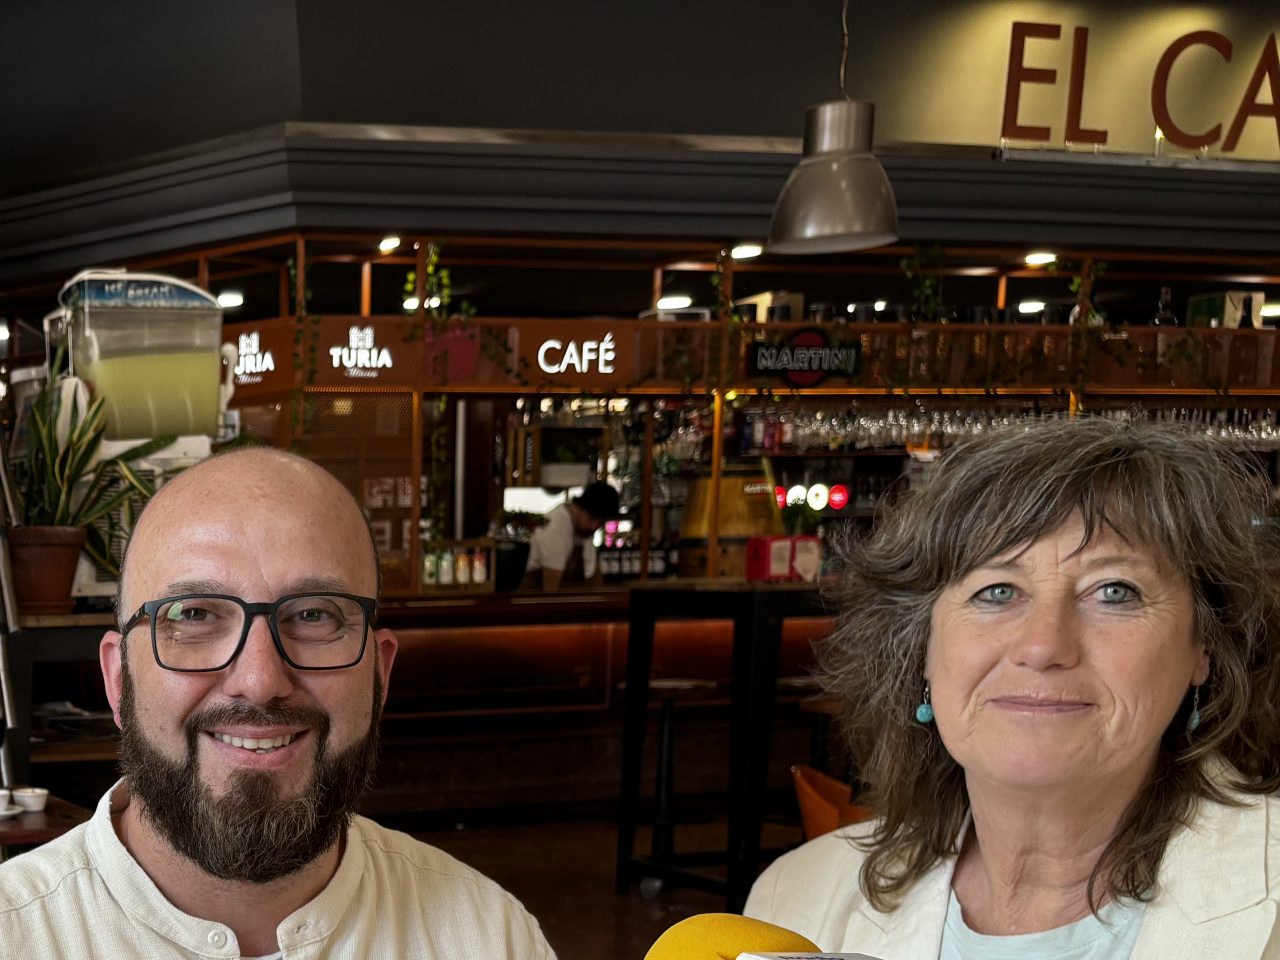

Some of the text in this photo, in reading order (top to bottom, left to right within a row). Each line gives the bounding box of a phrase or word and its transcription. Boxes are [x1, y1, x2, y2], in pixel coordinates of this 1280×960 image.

[1001, 21, 1109, 144] EL
[329, 345, 394, 369] TURIA
[537, 331, 616, 374] CAFÉ
[757, 346, 857, 373] MARTINI
